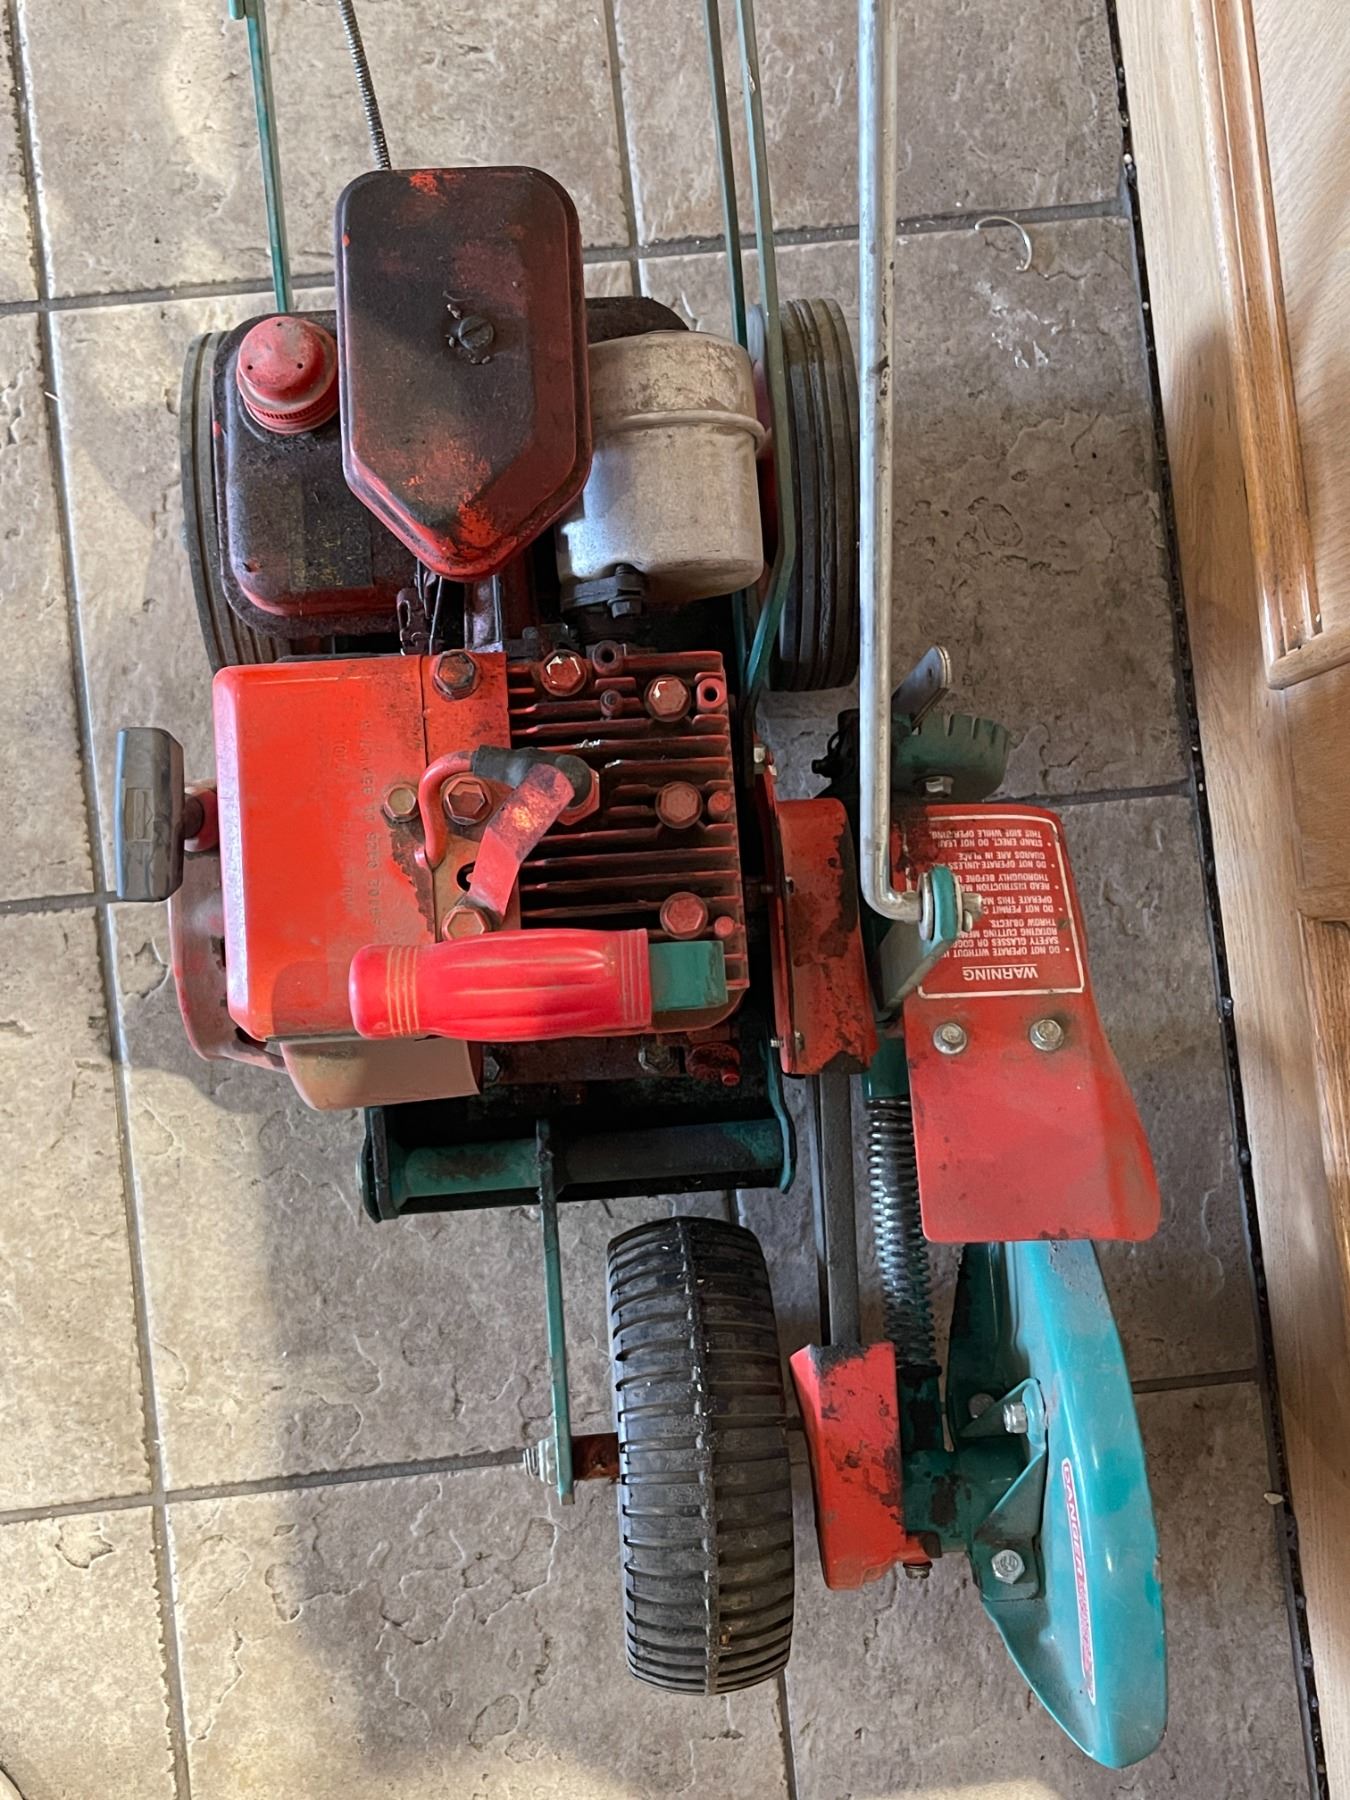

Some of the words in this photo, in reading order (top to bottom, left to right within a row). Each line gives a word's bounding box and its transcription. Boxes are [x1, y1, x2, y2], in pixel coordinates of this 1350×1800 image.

[977, 829, 1002, 837] WHILE
[1006, 829, 1022, 837] SIDE
[1025, 830, 1041, 838] THIS
[960, 839, 975, 847] NOT
[1020, 838, 1043, 846] STAND
[996, 851, 1011, 859] ARE
[1014, 851, 1045, 859] GUARDS
[966, 874, 995, 882] BEFORE
[999, 873, 1048, 882] THOROUGHLY
[976, 883, 1026, 891] INSTRUCTION
[997, 896, 1016, 904] THIS
[992, 905, 1021, 914] PERMIT
[989, 919, 1024, 927] OBJECTS.
[1028, 918, 1056, 926] THROW
[983, 929, 1017, 937] CUTTING
[1021, 927, 1057, 936] ROTATING
[977, 939, 988, 947] OR
[991, 937, 1026, 946] GLASSES
[1030, 936, 1059, 944] SAFETY
[953, 949, 989, 957] WITHOUT
[992, 947, 1027, 956] OPERATE
[1031, 946, 1046, 954] NOT
[1049, 946, 1060, 954] DO
[962, 967, 1038, 981] WARNING
[1064, 1465, 1084, 1577] DANGER
